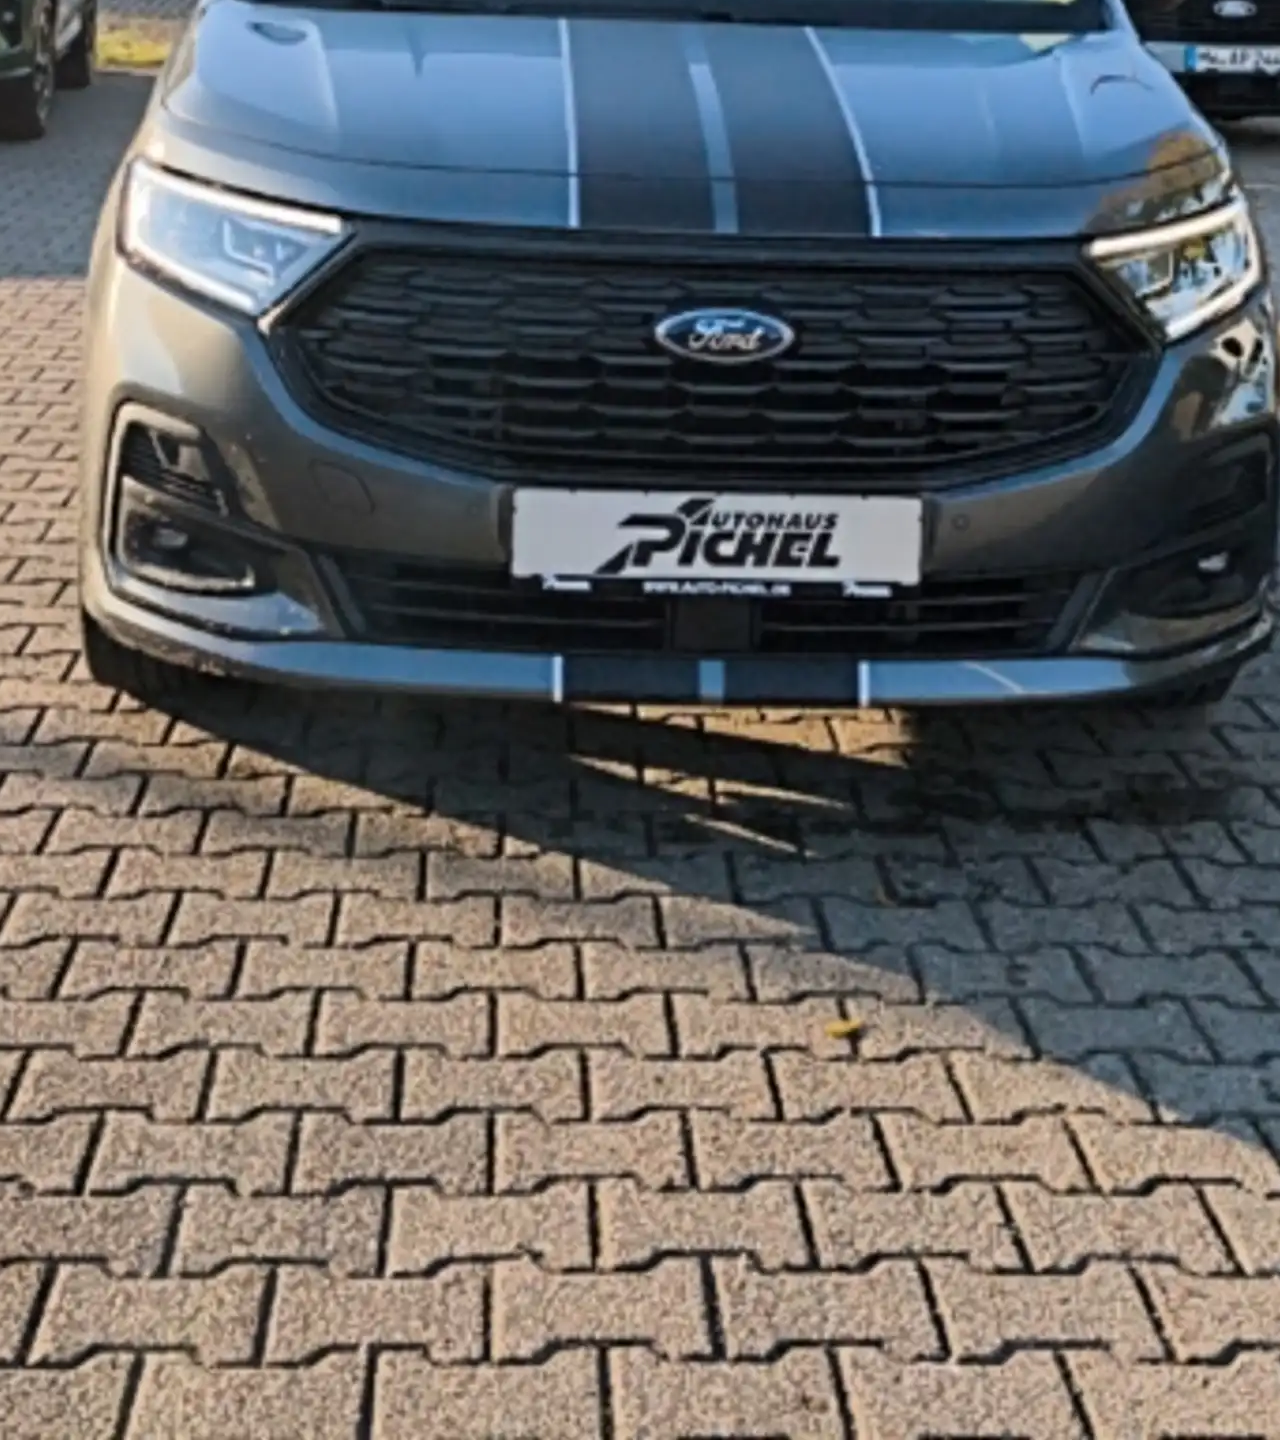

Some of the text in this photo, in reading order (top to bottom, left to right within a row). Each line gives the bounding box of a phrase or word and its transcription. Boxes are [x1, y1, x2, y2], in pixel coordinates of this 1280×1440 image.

[688, 318, 766, 351] Ford
[682, 505, 839, 530] AUTOHAUS
[616, 513, 841, 568] PICHEL
